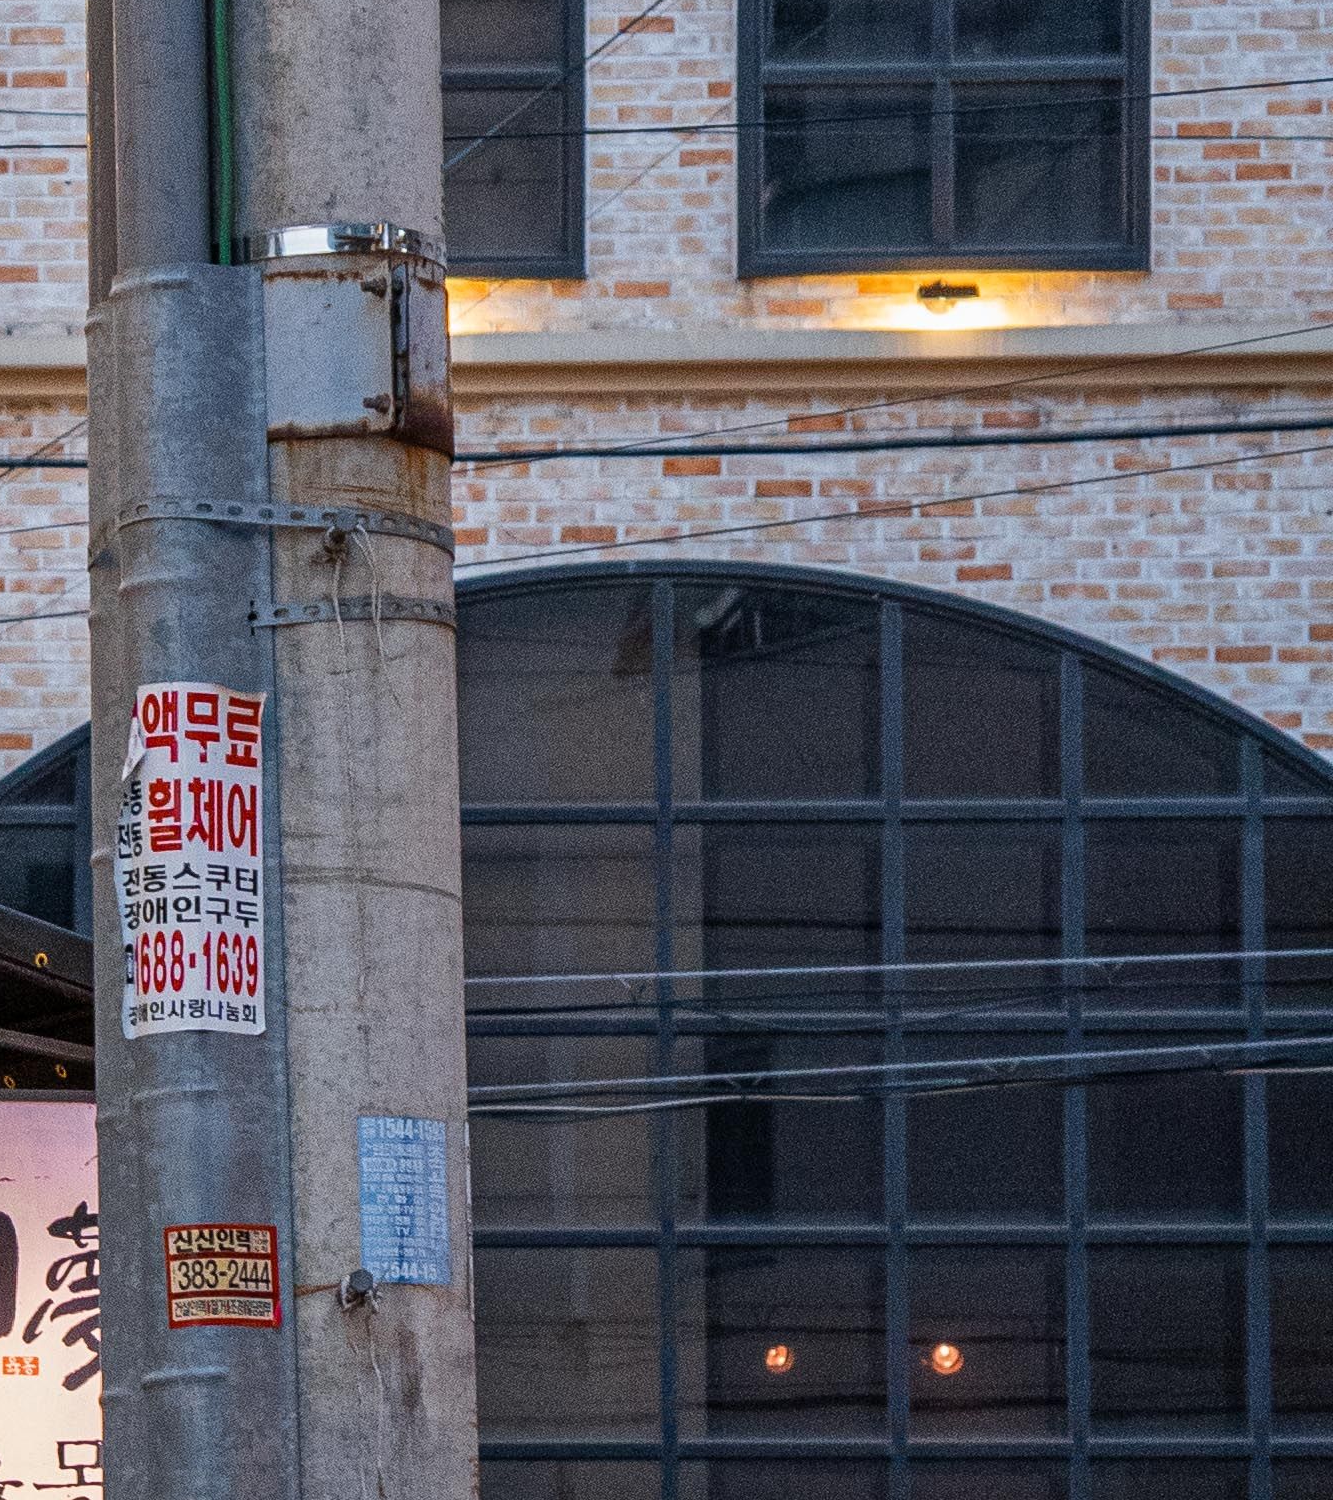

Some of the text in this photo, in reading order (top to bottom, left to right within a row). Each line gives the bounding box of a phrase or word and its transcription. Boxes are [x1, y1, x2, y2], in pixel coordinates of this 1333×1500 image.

[132, 690, 261, 768] 액무료
[148, 777, 258, 858] 휠체어
[122, 862, 259, 897] 전동스쿠터
[124, 895, 259, 930] 장애인구두
[173, 1228, 251, 1254] 신신인력
[177, 1259, 271, 1291] 383-2444
